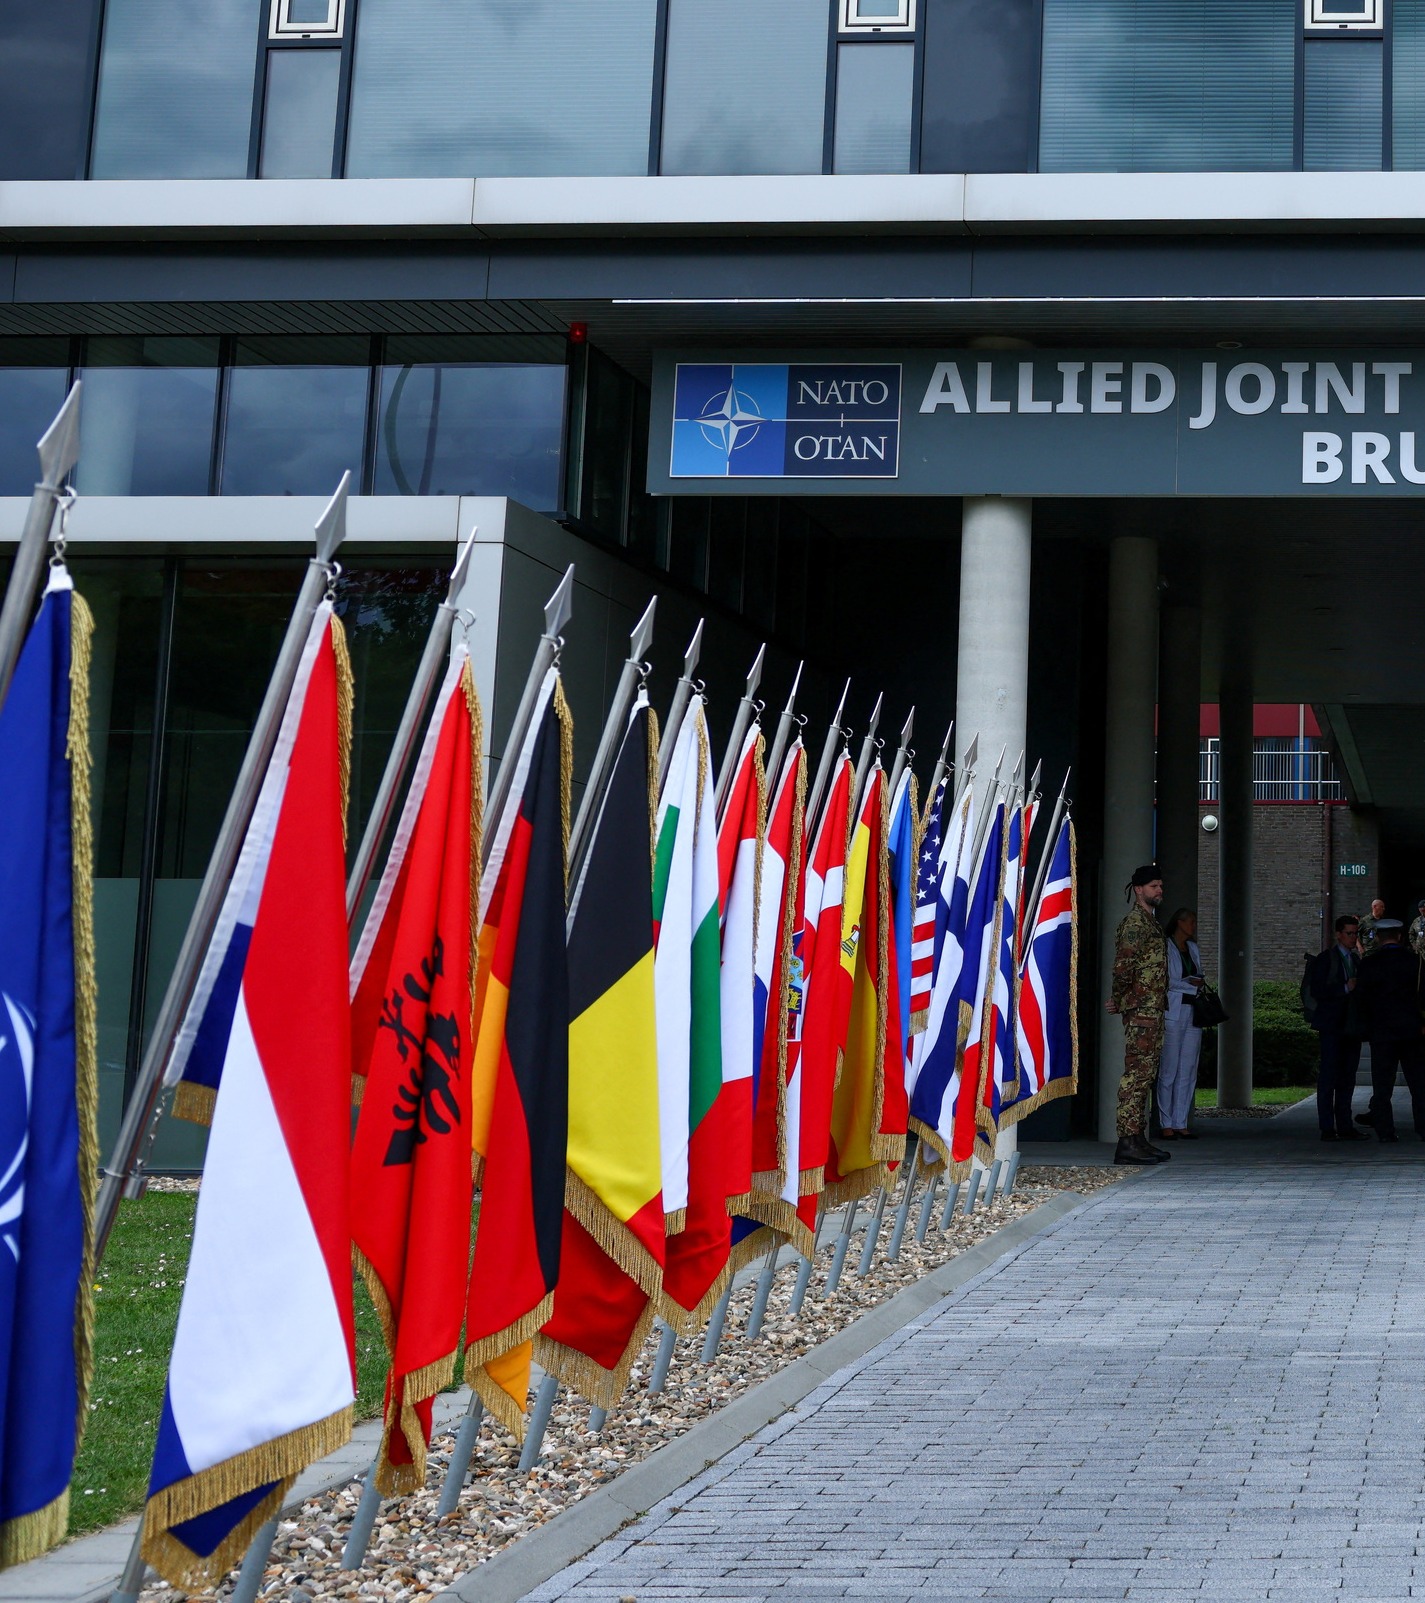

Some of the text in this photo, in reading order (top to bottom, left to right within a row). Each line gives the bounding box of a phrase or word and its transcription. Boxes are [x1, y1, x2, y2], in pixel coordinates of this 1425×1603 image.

[797, 380, 889, 405] NATO
[918, 361, 1177, 414] ALLIED
[1189, 361, 1413, 430] JOINT
[794, 435, 888, 461] OTAN
[1340, 864, 1366, 875] H-106
